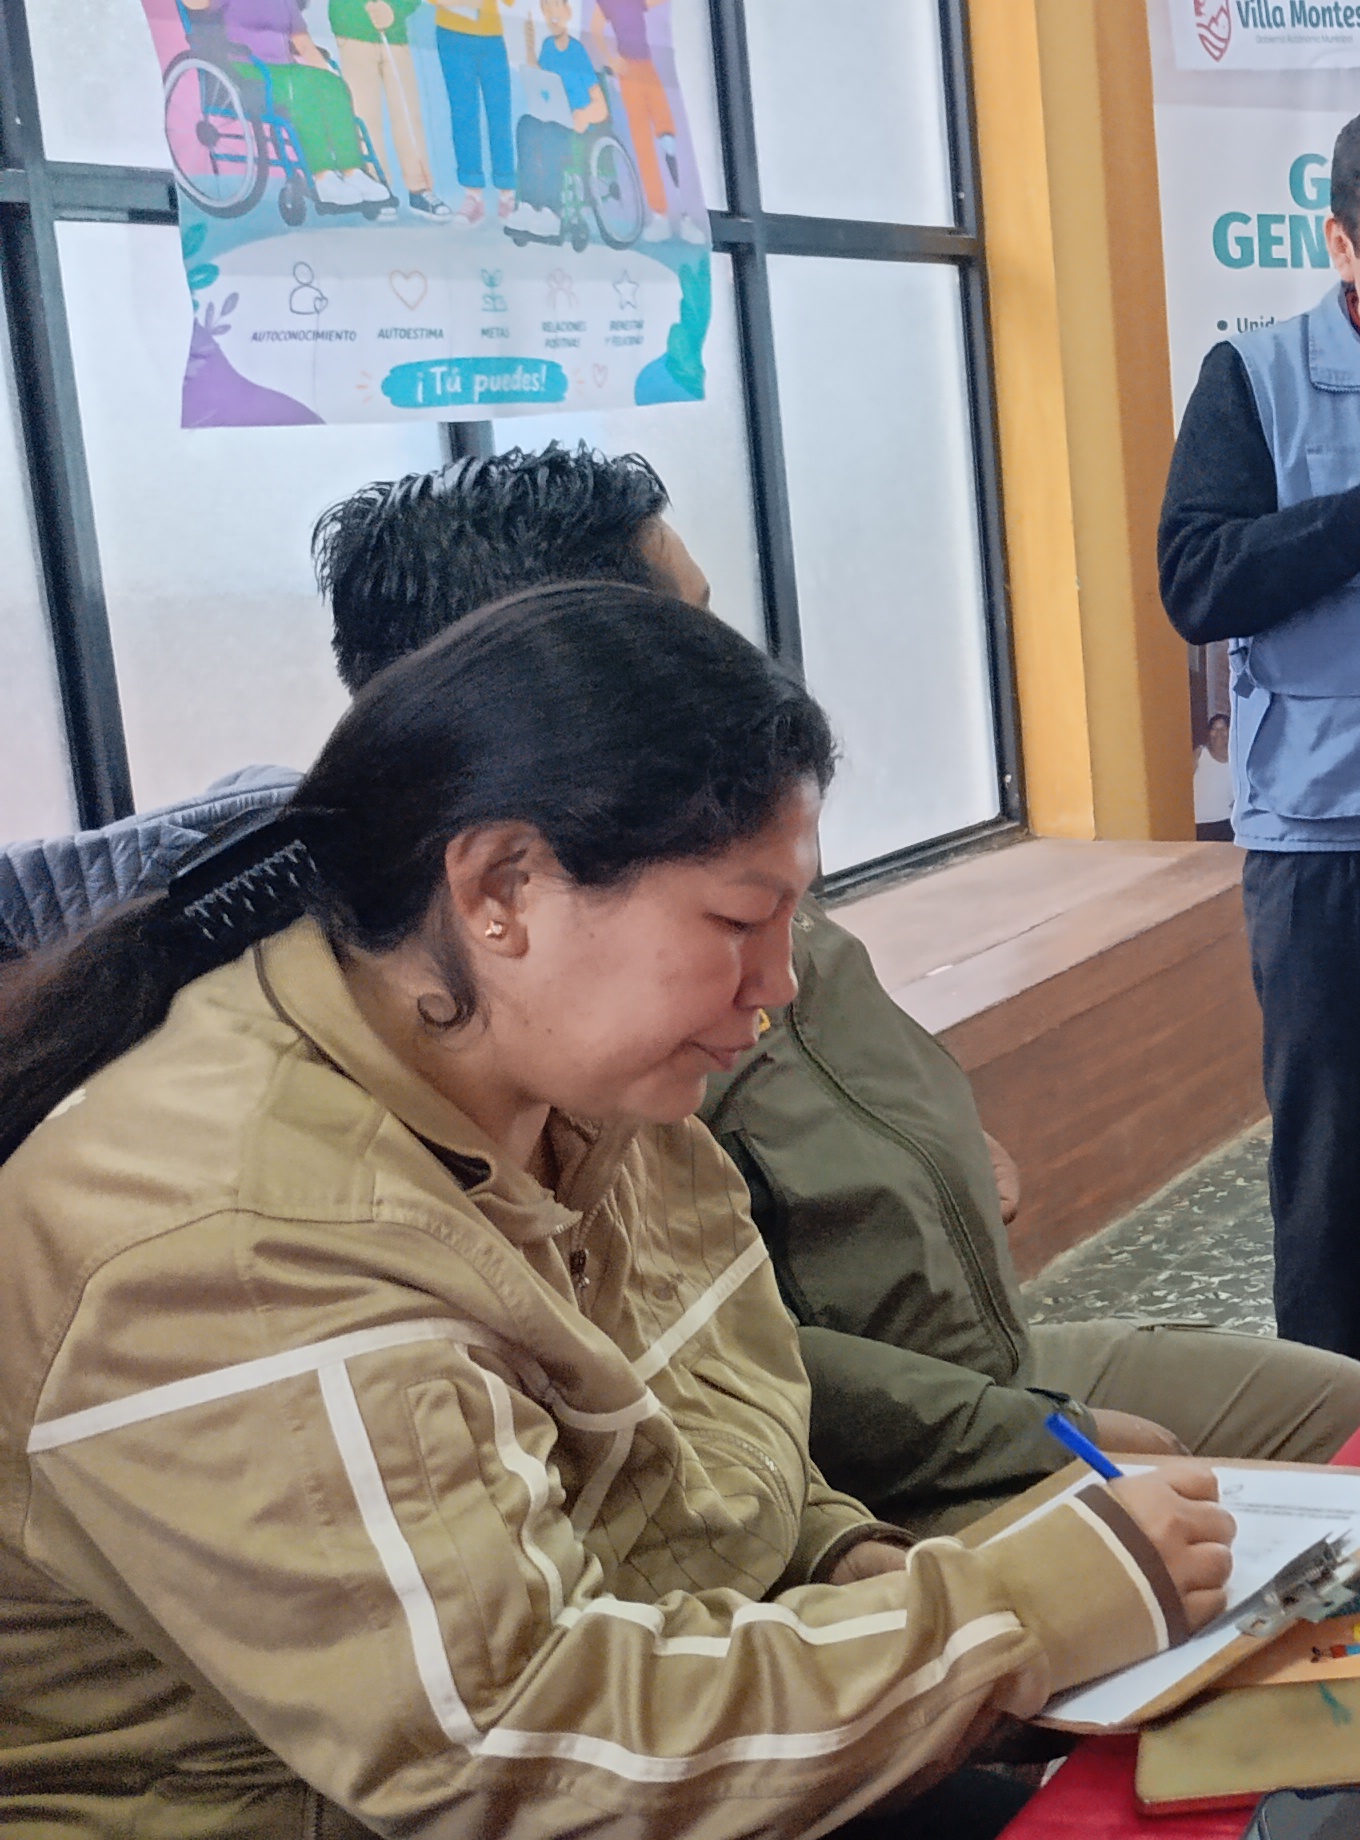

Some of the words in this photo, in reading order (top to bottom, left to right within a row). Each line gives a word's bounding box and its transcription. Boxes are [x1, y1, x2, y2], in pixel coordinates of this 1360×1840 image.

[1236, 0, 1286, 29] Villa
[250, 329, 357, 342] AUTOCONOCIMIENTO
[377, 327, 444, 340] AUTOESTIMA
[473, 365, 547, 404] puedes!
